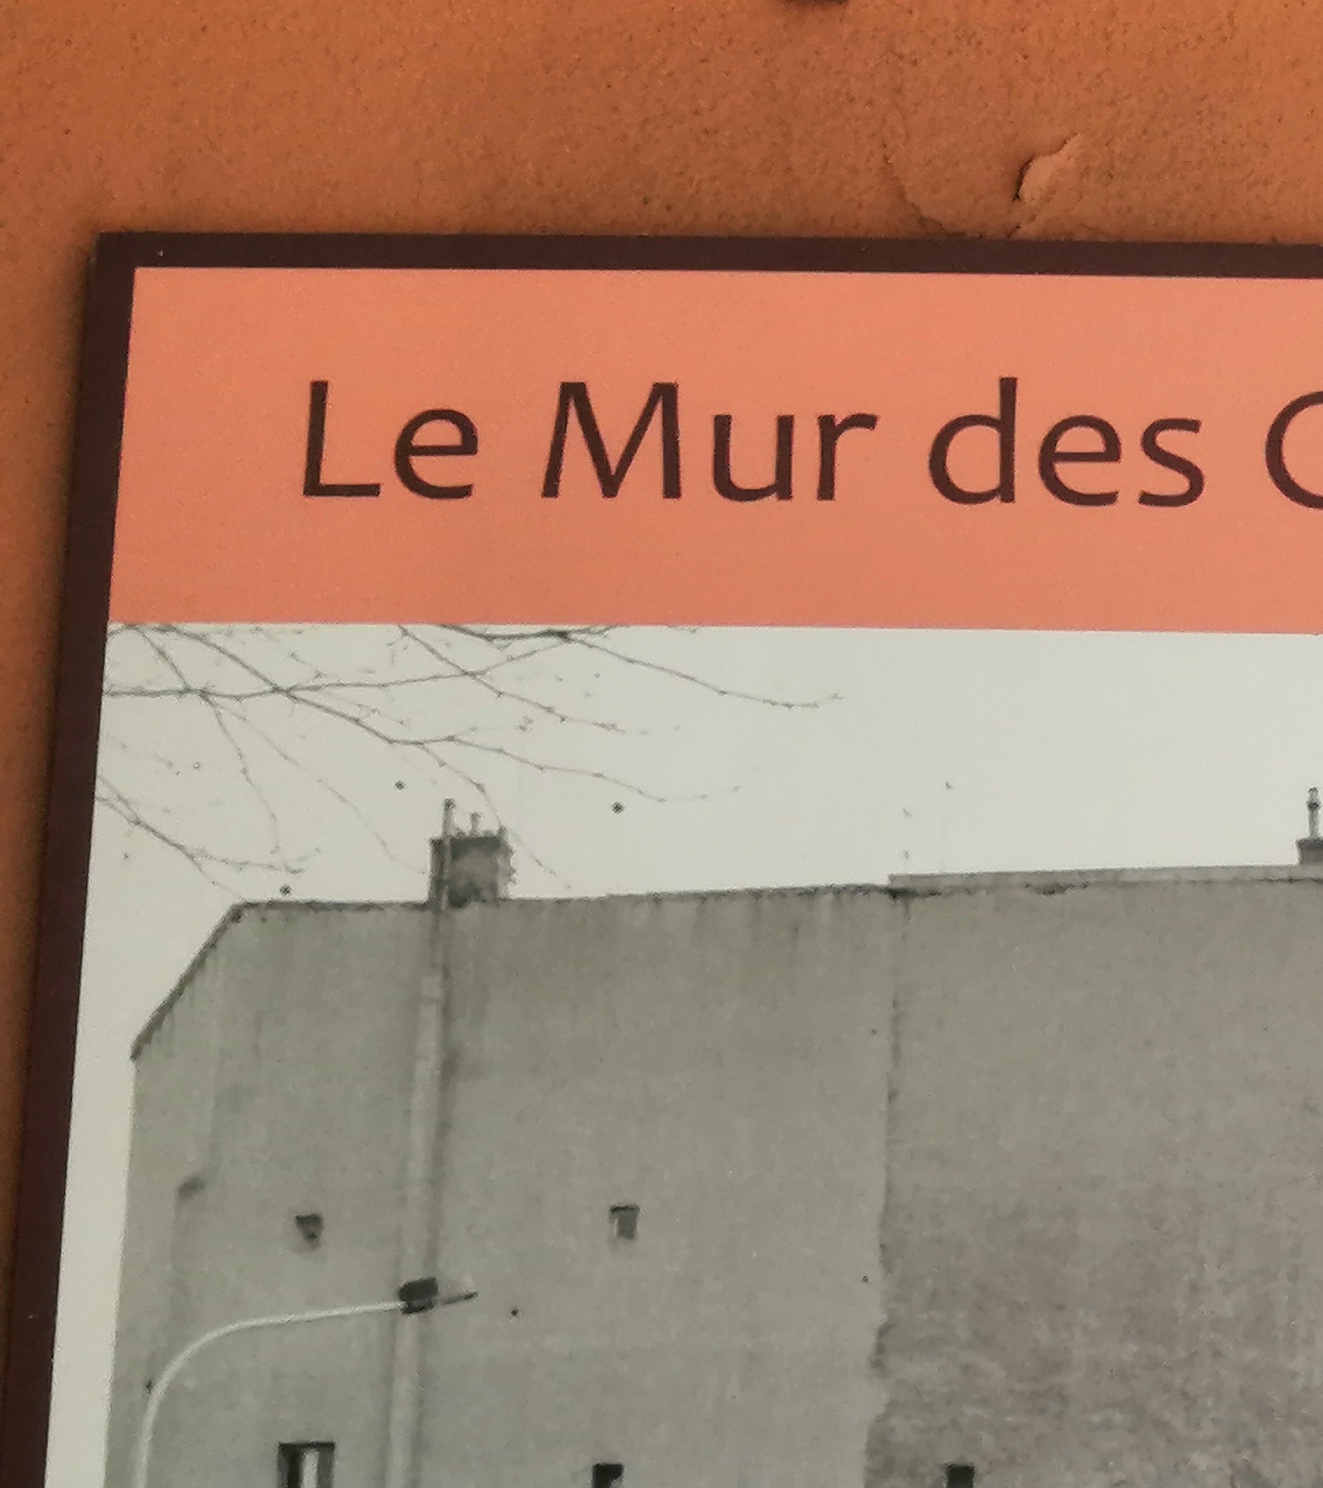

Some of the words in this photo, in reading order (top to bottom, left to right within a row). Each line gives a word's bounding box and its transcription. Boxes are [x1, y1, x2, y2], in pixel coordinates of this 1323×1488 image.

[301, 379, 479, 502] Le
[540, 380, 879, 504] Mur
[927, 376, 1206, 508] des
